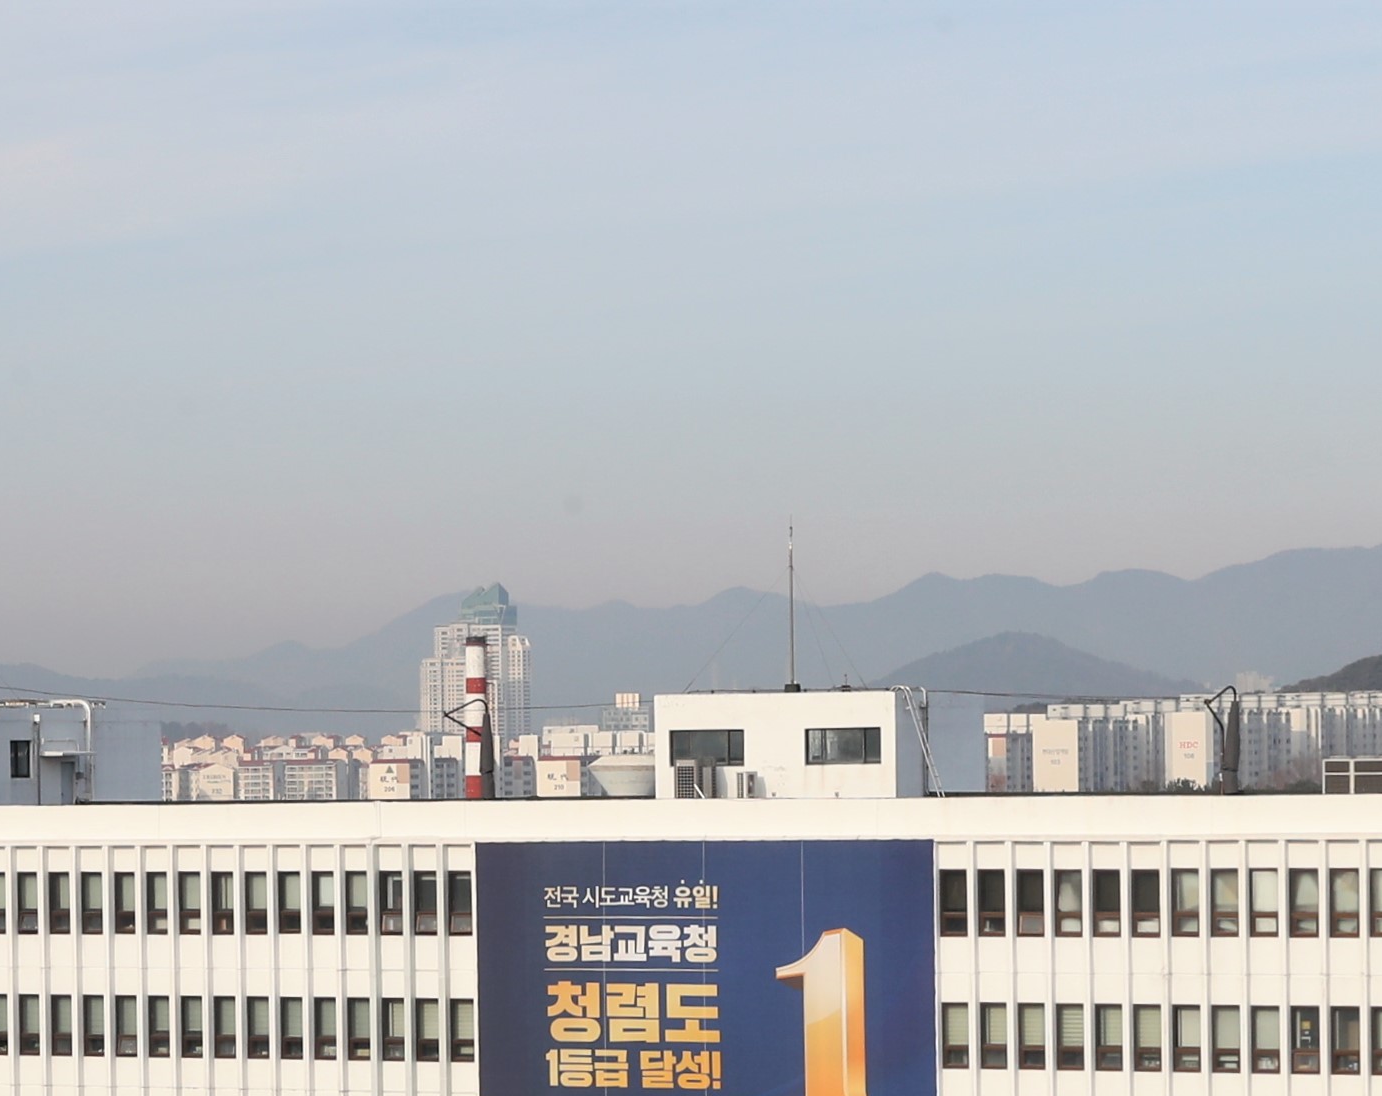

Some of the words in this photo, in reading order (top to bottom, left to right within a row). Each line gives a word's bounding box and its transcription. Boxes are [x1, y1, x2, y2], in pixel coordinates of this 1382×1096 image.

[543, 884, 580, 909] 전국
[582, 884, 669, 909] 시도교육청
[673, 884, 718, 909] 유일!
[544, 924, 718, 963] 경남교육청
[547, 980, 721, 1043] 청렴도
[545, 1048, 629, 1088] 1등급
[639, 1050, 722, 1090] 달성!
